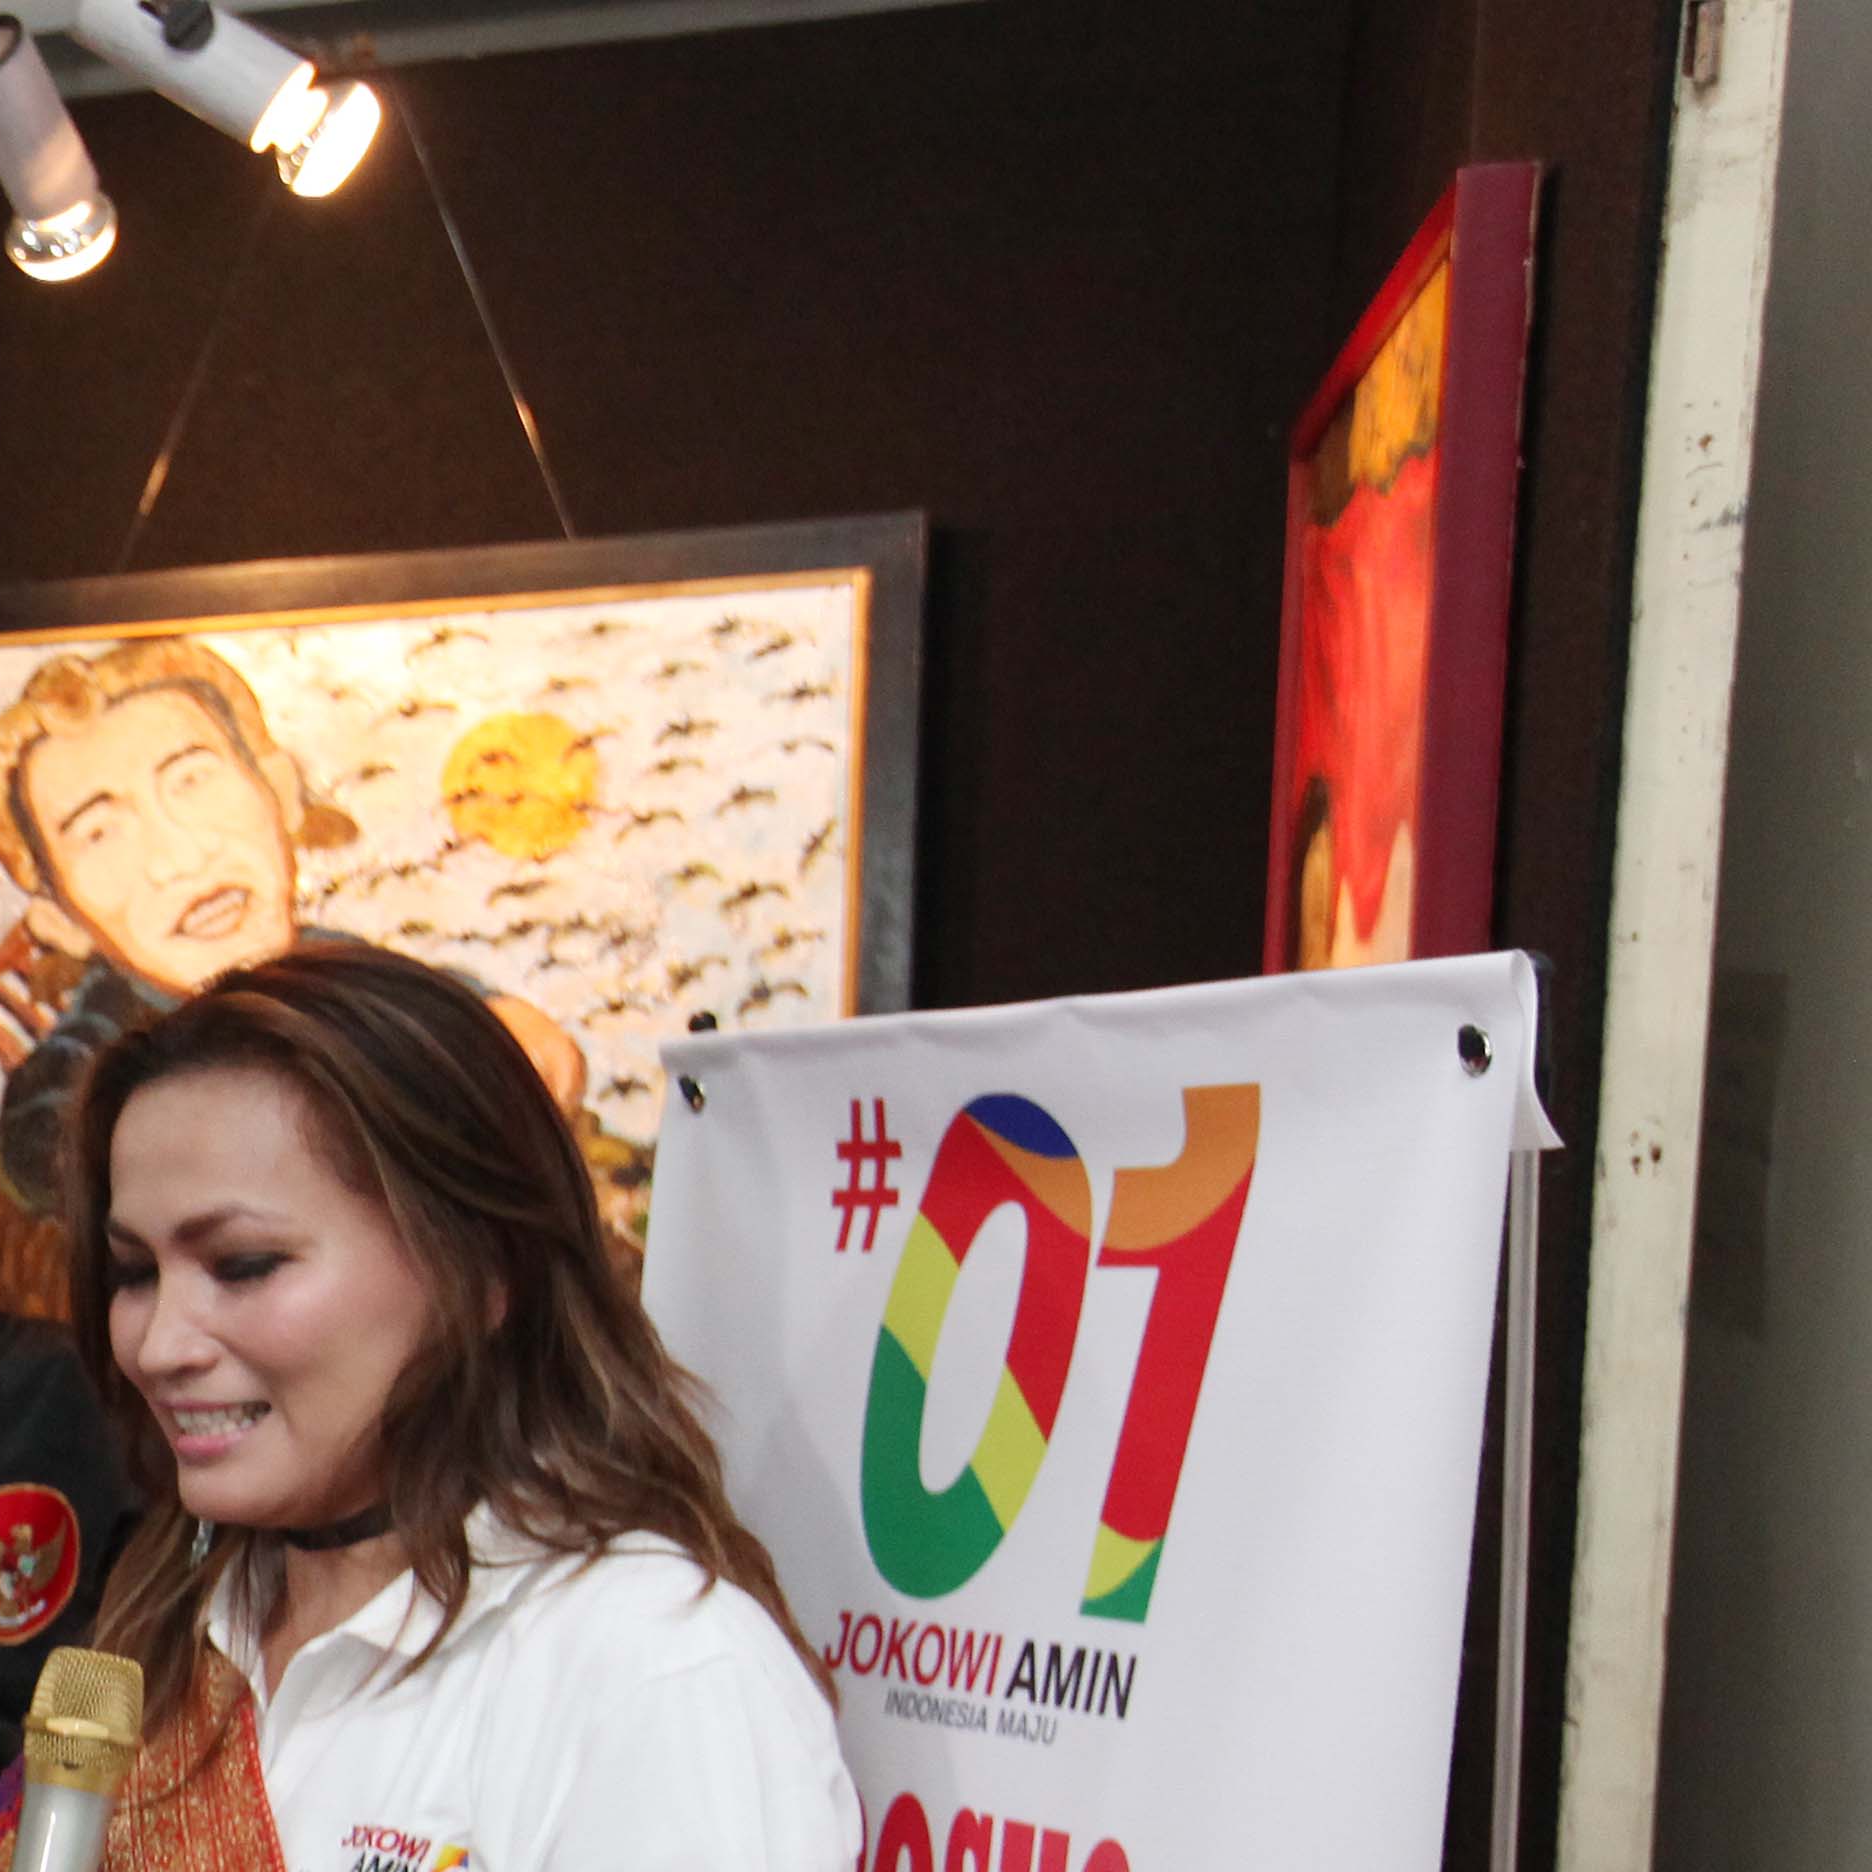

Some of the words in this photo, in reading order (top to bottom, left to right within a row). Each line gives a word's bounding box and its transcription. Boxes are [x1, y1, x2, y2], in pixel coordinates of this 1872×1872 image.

[830, 1081, 1261, 1625] #01
[823, 1609, 1004, 1697] JOKOWI
[1004, 1637, 1138, 1721] AMIN
[883, 1687, 988, 1734] INDONESIA
[995, 1709, 1059, 1746] MAJU
